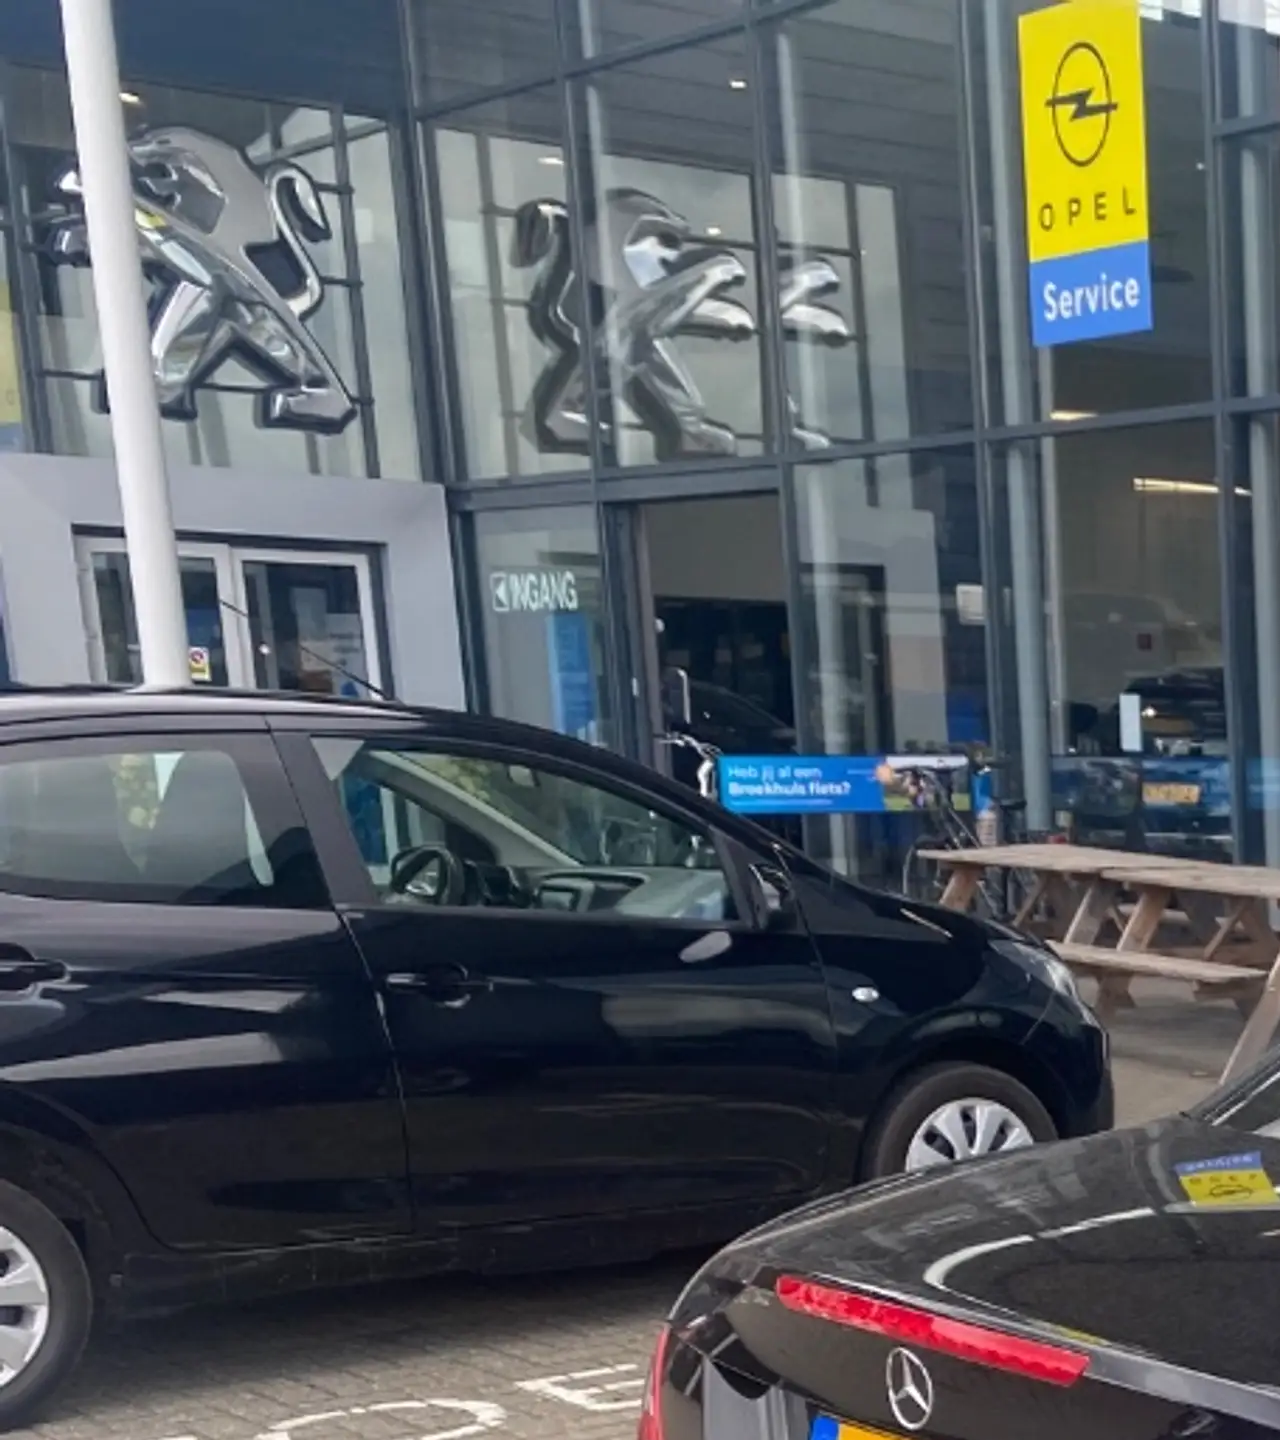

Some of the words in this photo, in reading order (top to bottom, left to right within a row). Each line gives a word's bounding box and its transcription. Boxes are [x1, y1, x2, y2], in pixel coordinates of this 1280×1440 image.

[1038, 185, 1137, 232] OPEL
[1043, 271, 1141, 322] Service
[508, 570, 579, 612] INGANG
